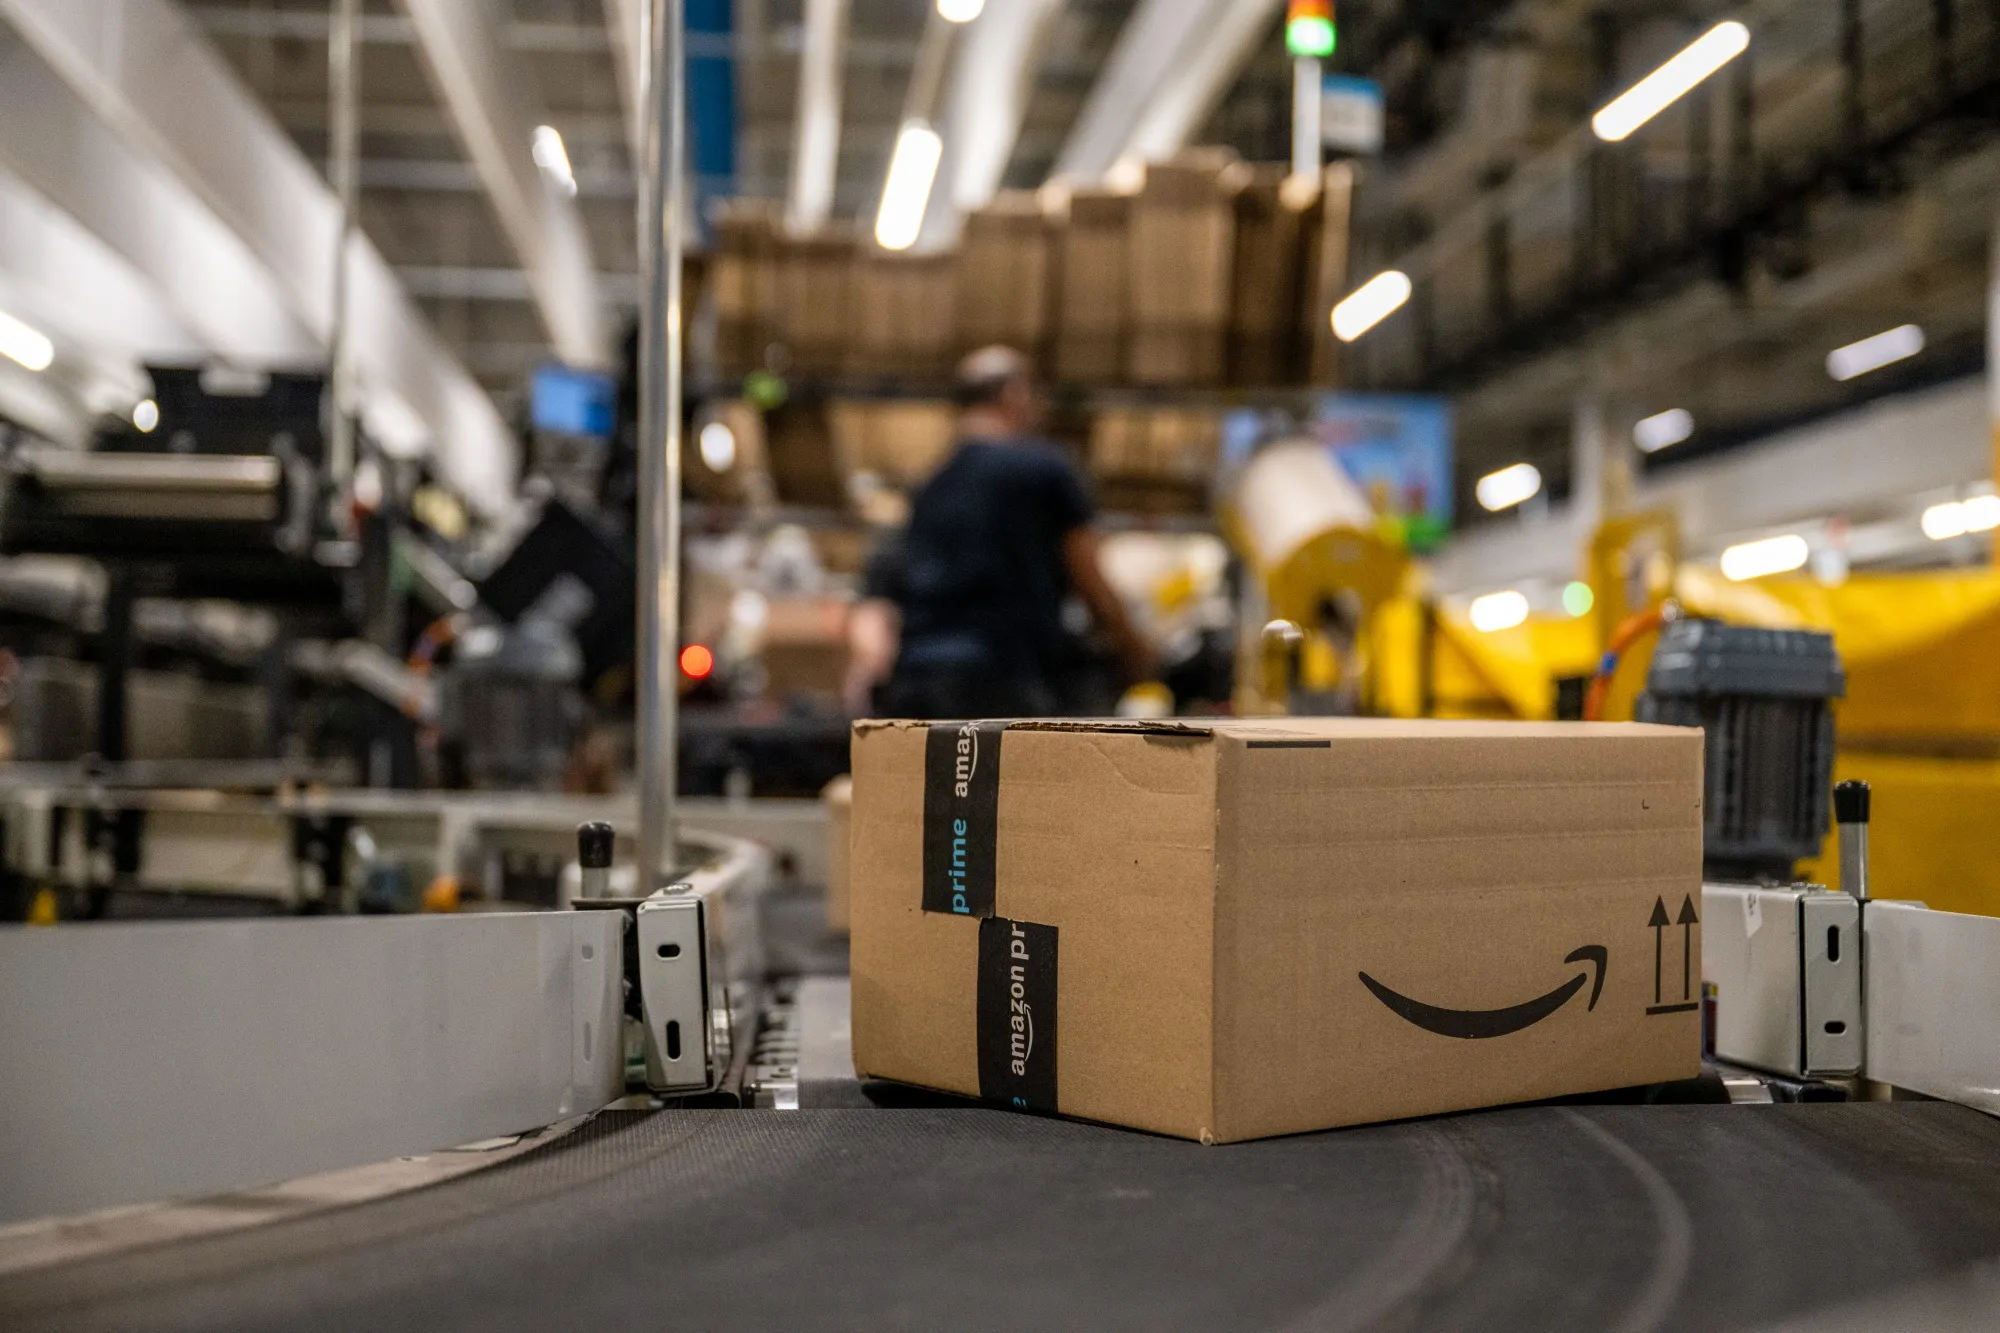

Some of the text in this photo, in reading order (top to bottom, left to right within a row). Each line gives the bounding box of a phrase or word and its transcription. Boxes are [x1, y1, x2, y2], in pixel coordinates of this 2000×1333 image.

[948, 818, 970, 914] prime
[1010, 921, 1030, 960] pr
[1010, 965, 1028, 1076] amazon
